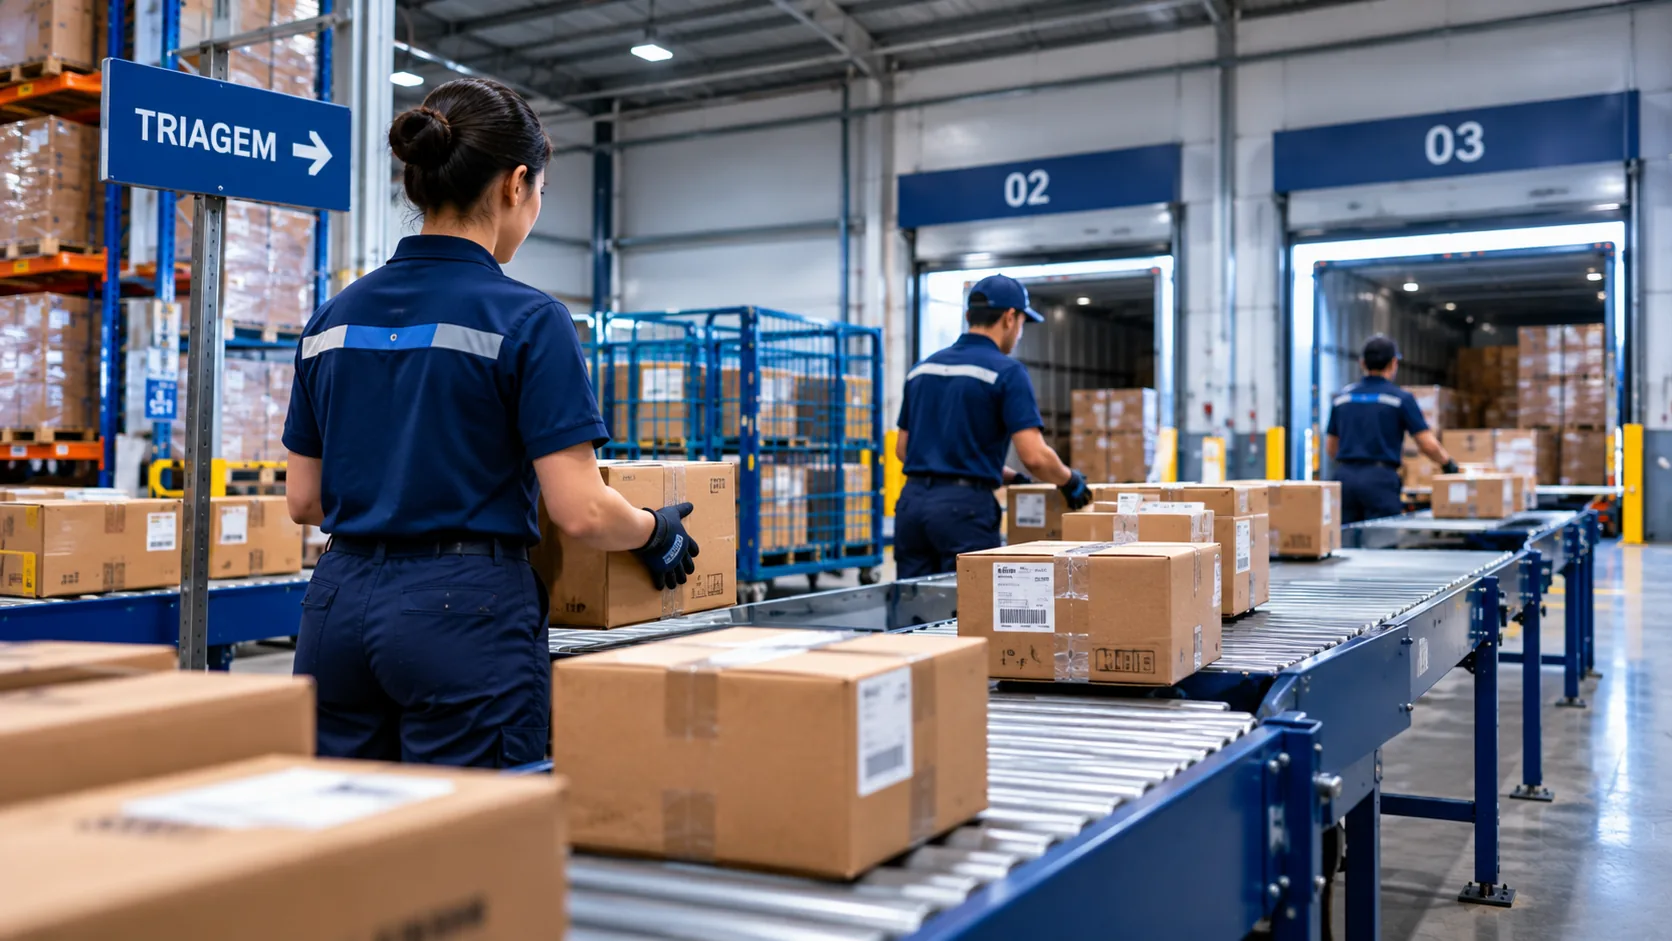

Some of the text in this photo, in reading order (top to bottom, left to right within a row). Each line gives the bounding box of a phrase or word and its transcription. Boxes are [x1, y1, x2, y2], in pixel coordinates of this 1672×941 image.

[135, 107, 277, 162] TRIAGEM
[1424, 121, 1485, 166] 03
[1004, 169, 1050, 208] 02
